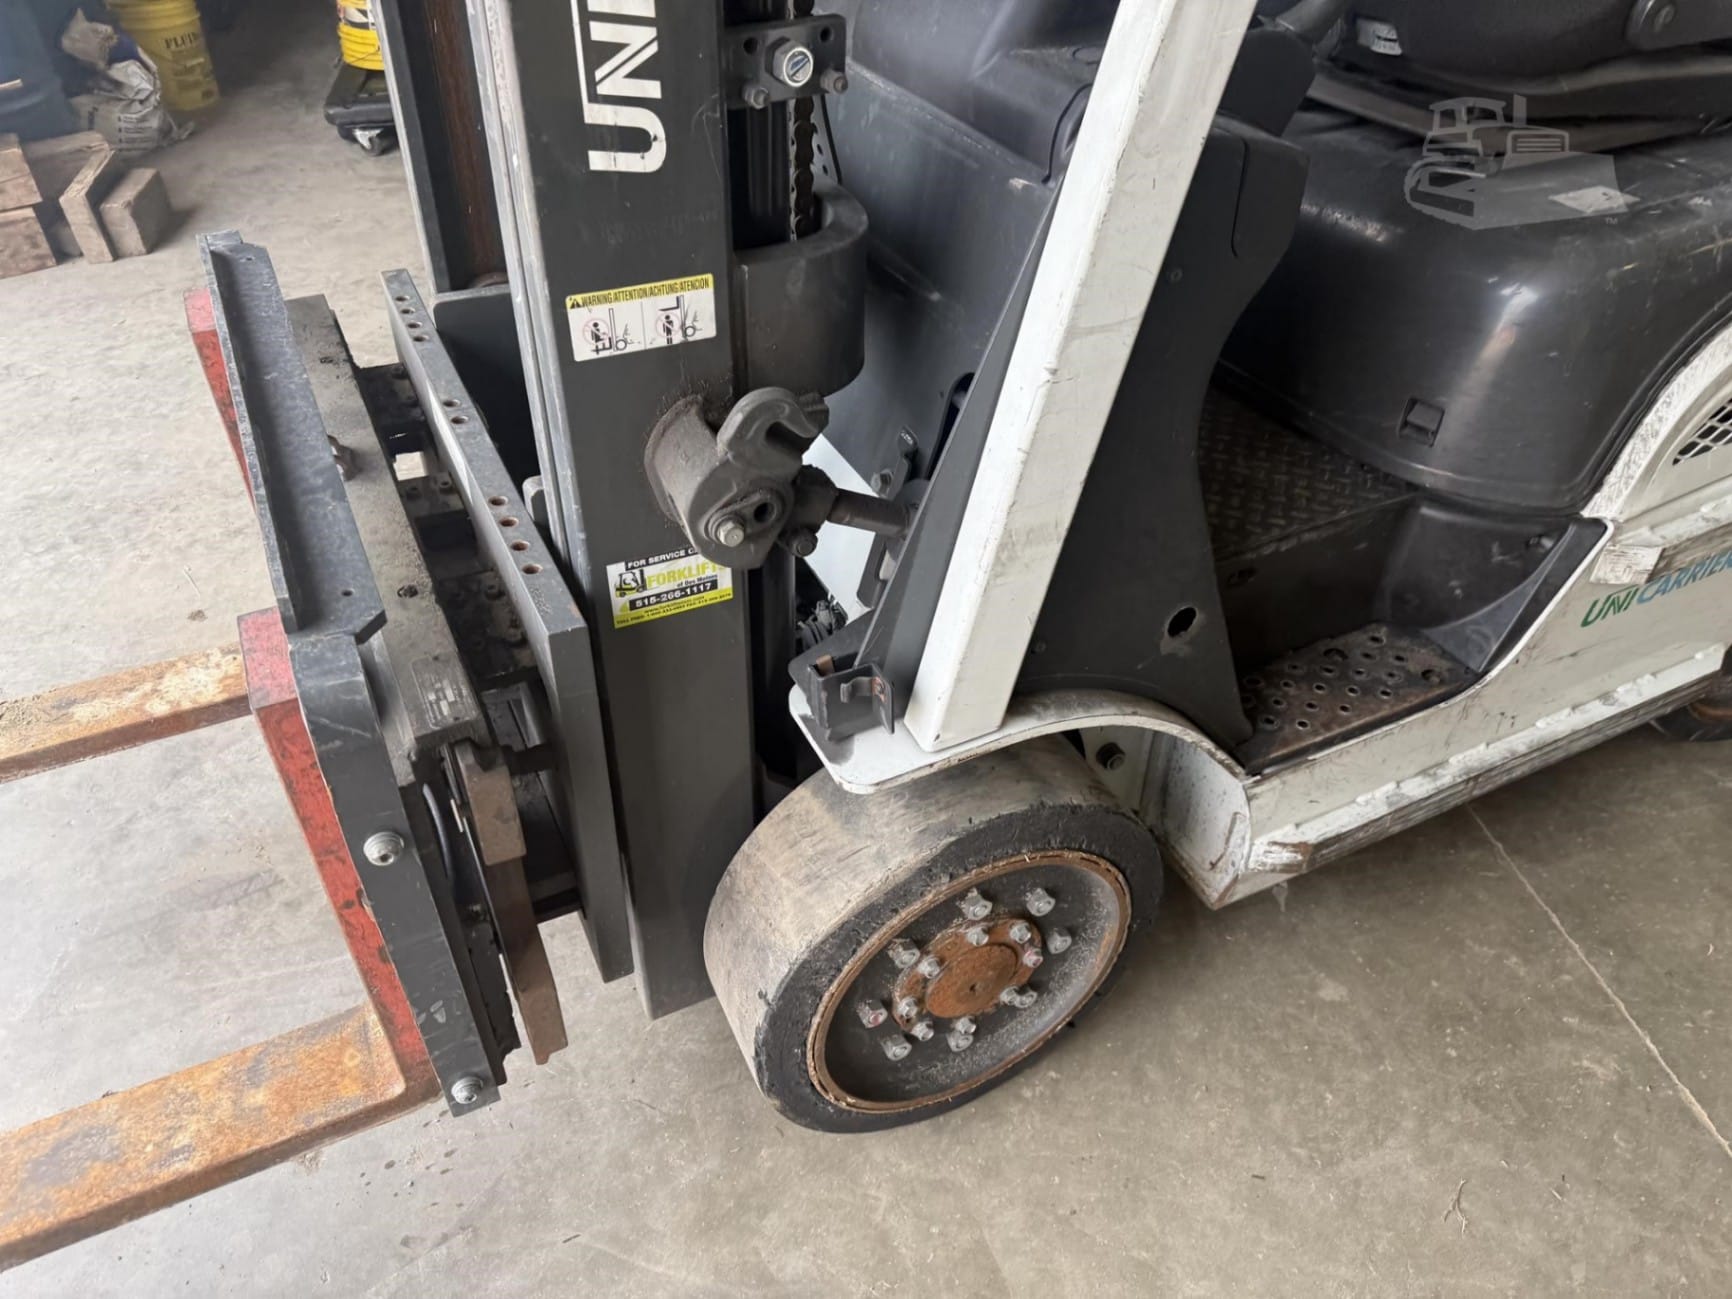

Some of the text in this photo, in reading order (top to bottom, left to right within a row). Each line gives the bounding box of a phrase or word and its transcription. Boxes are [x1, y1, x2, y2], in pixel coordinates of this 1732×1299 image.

[628, 558, 646, 569] FOR
[648, 549, 686, 565] SERVICE
[635, 582, 712, 608] 515-266-1117
